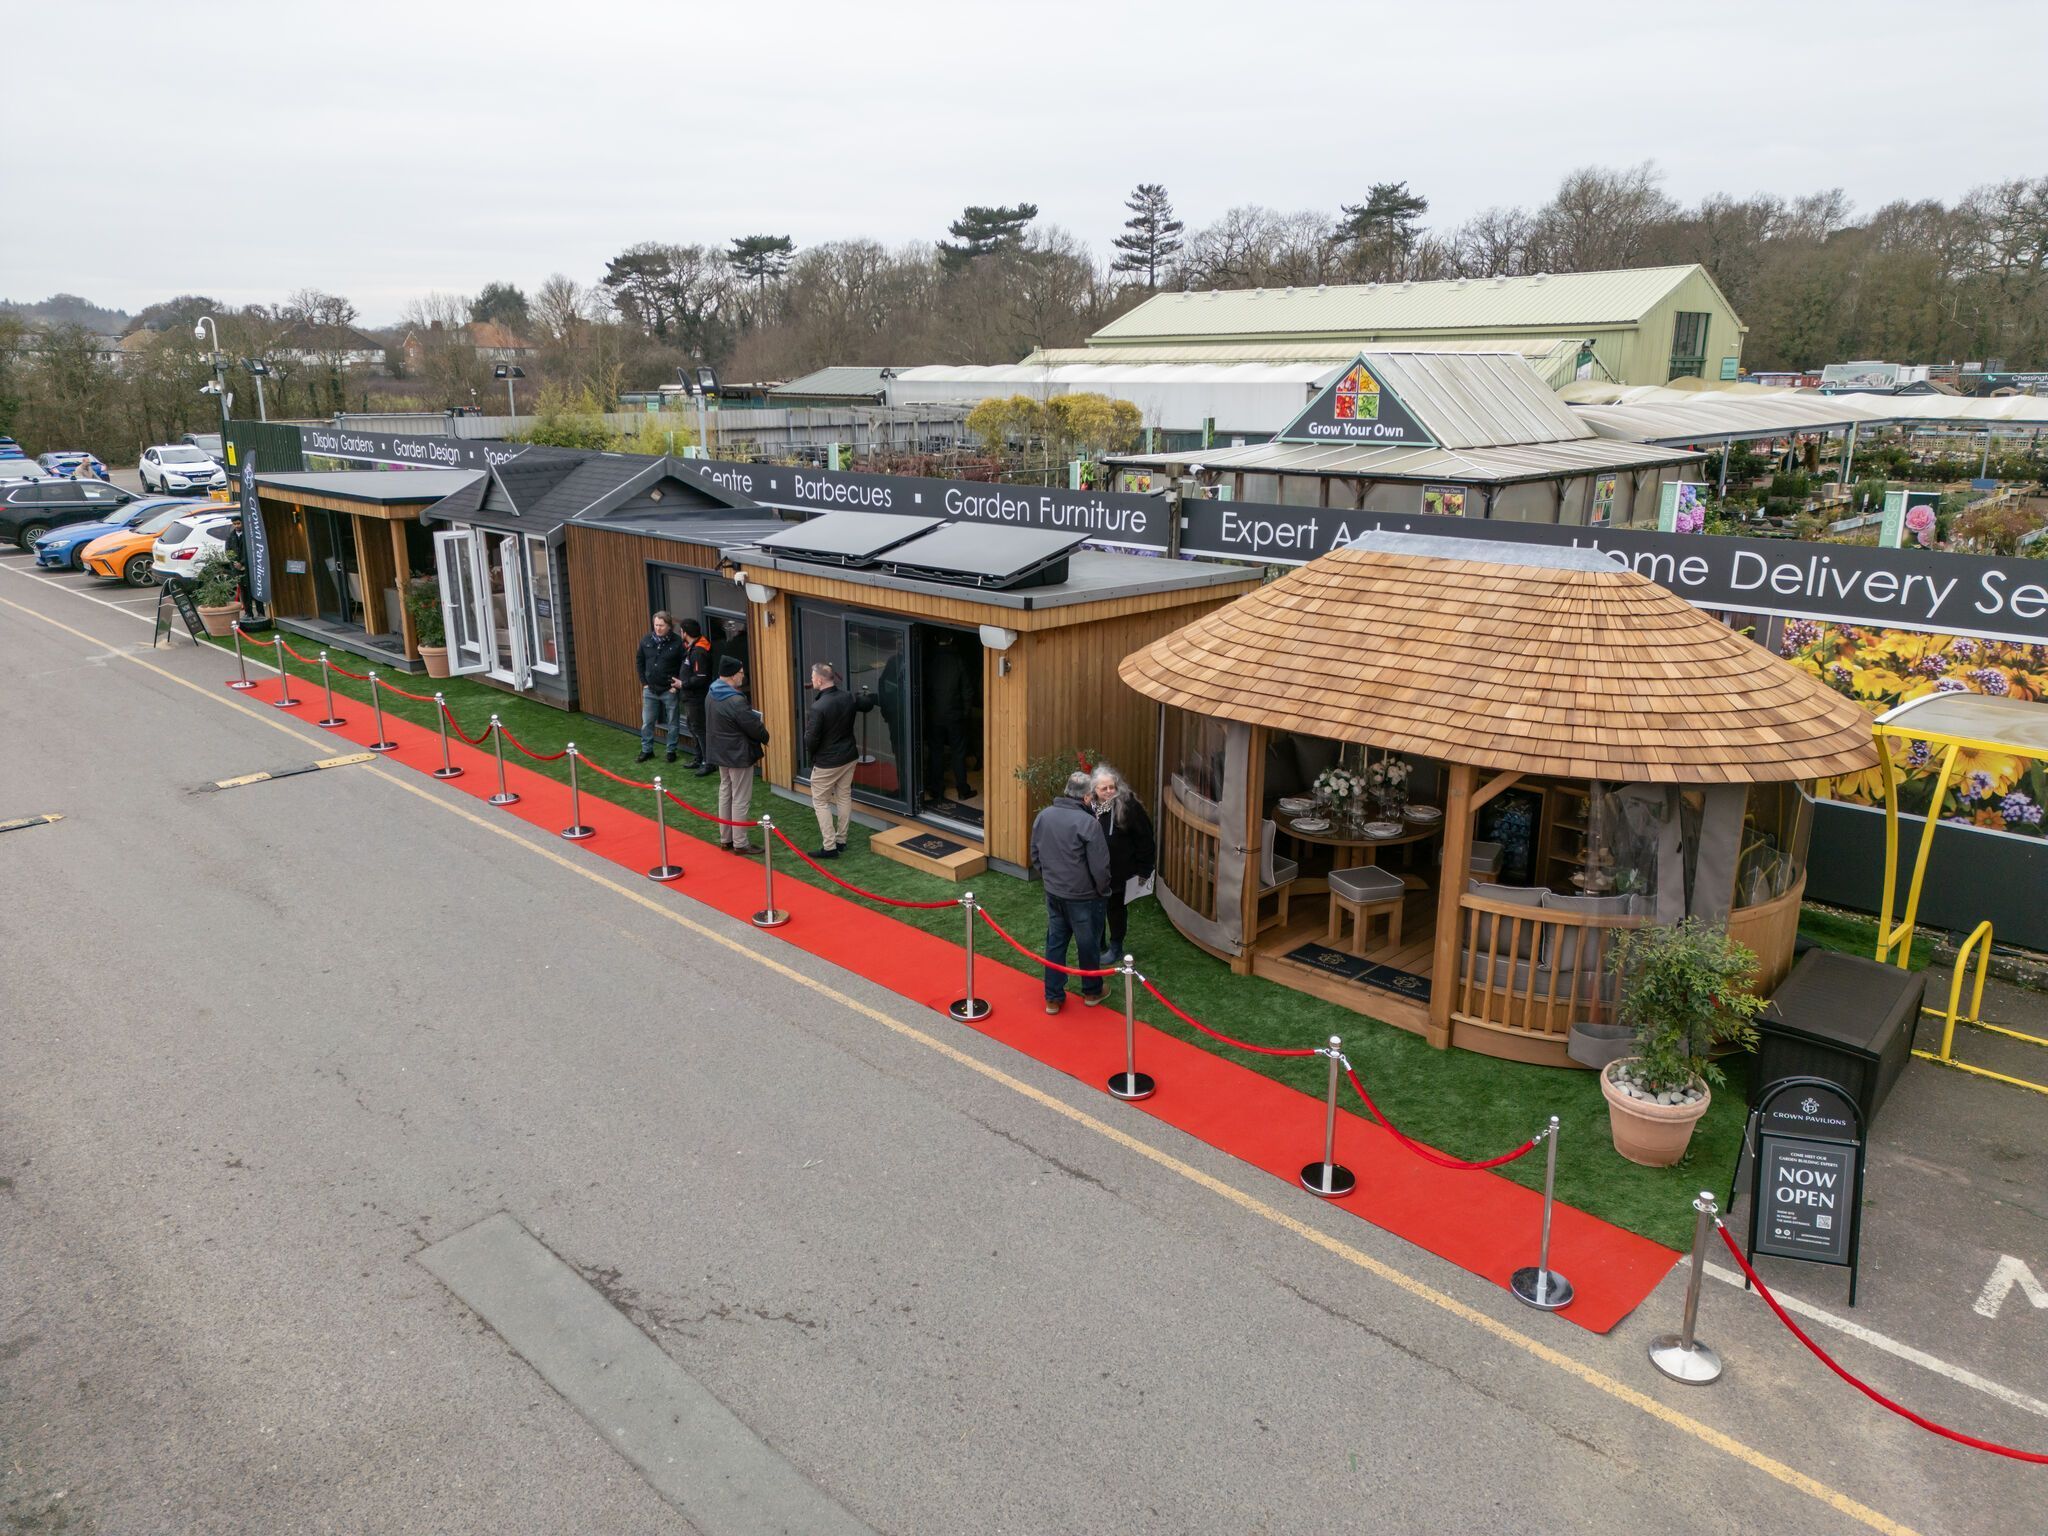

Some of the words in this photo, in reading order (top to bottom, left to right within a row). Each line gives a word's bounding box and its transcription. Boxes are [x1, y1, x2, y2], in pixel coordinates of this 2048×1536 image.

[312, 432, 339, 452] Display
[340, 435, 374, 453] Gardens
[1308, 422, 1340, 435] Grow
[1343, 423, 1372, 436] Your
[1374, 424, 1404, 437] Own
[393, 439, 427, 458] Garden
[429, 442, 461, 465] Design
[794, 474, 892, 508] Barbecues
[945, 488, 1030, 522] Garden
[1040, 496, 1147, 533] Furniture
[1884, 496, 1899, 536] ROSES
[1222, 511, 1318, 552] Expert
[249, 496, 262, 540] Crown
[256, 543, 265, 598] Pavilions
[1730, 550, 1959, 618] Delivery
[1772, 1111, 1804, 1121] CROWN
[1805, 1115, 1847, 1126] PAVILIONS
[1798, 1158, 1820, 1166] BUILDING
[1779, 1166, 1837, 1189] NOW
[1776, 1186, 1835, 1209] OPEN
